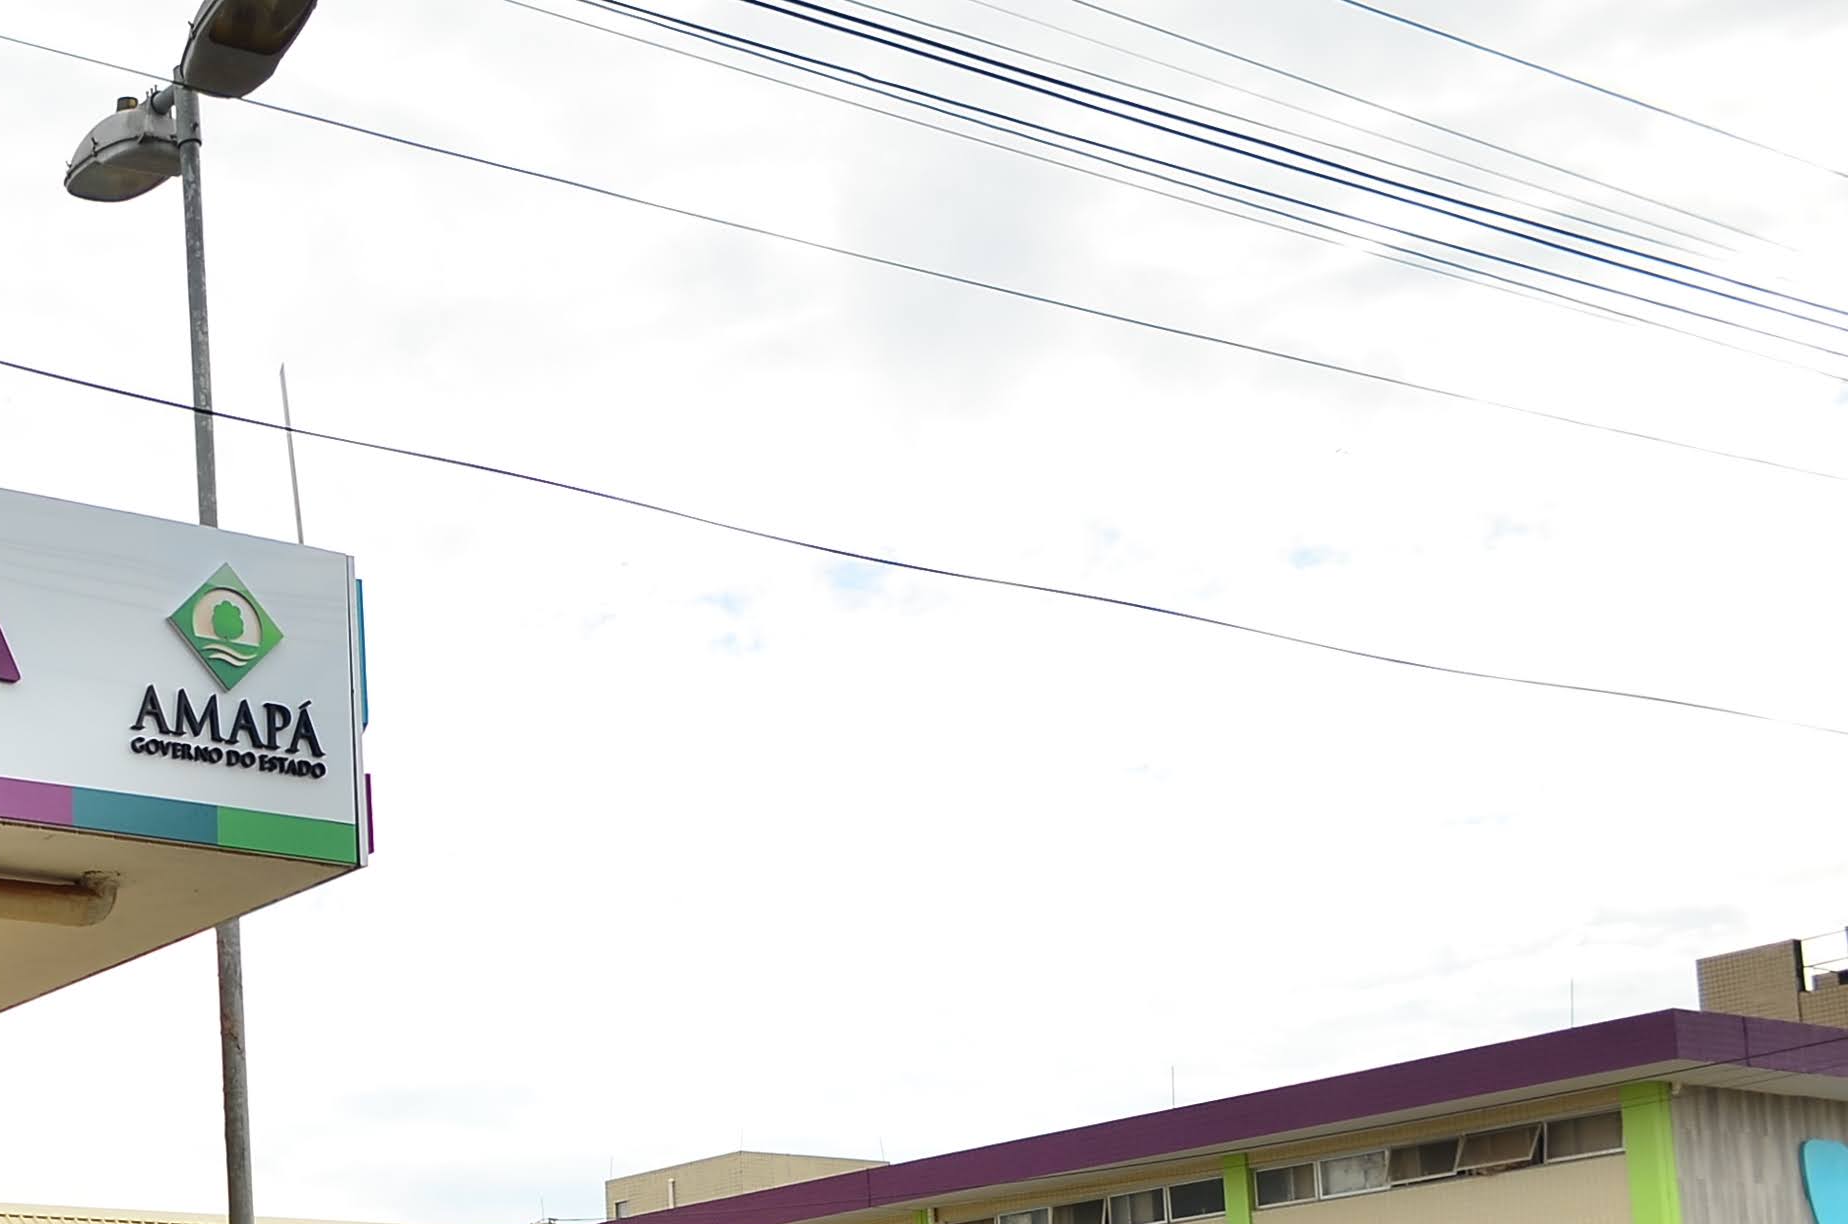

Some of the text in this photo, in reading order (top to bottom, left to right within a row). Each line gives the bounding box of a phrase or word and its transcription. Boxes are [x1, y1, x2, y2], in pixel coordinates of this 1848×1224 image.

[130, 684, 326, 757] AMAPÁ
[130, 736, 327, 779] GOVERNO DO ESTADO
